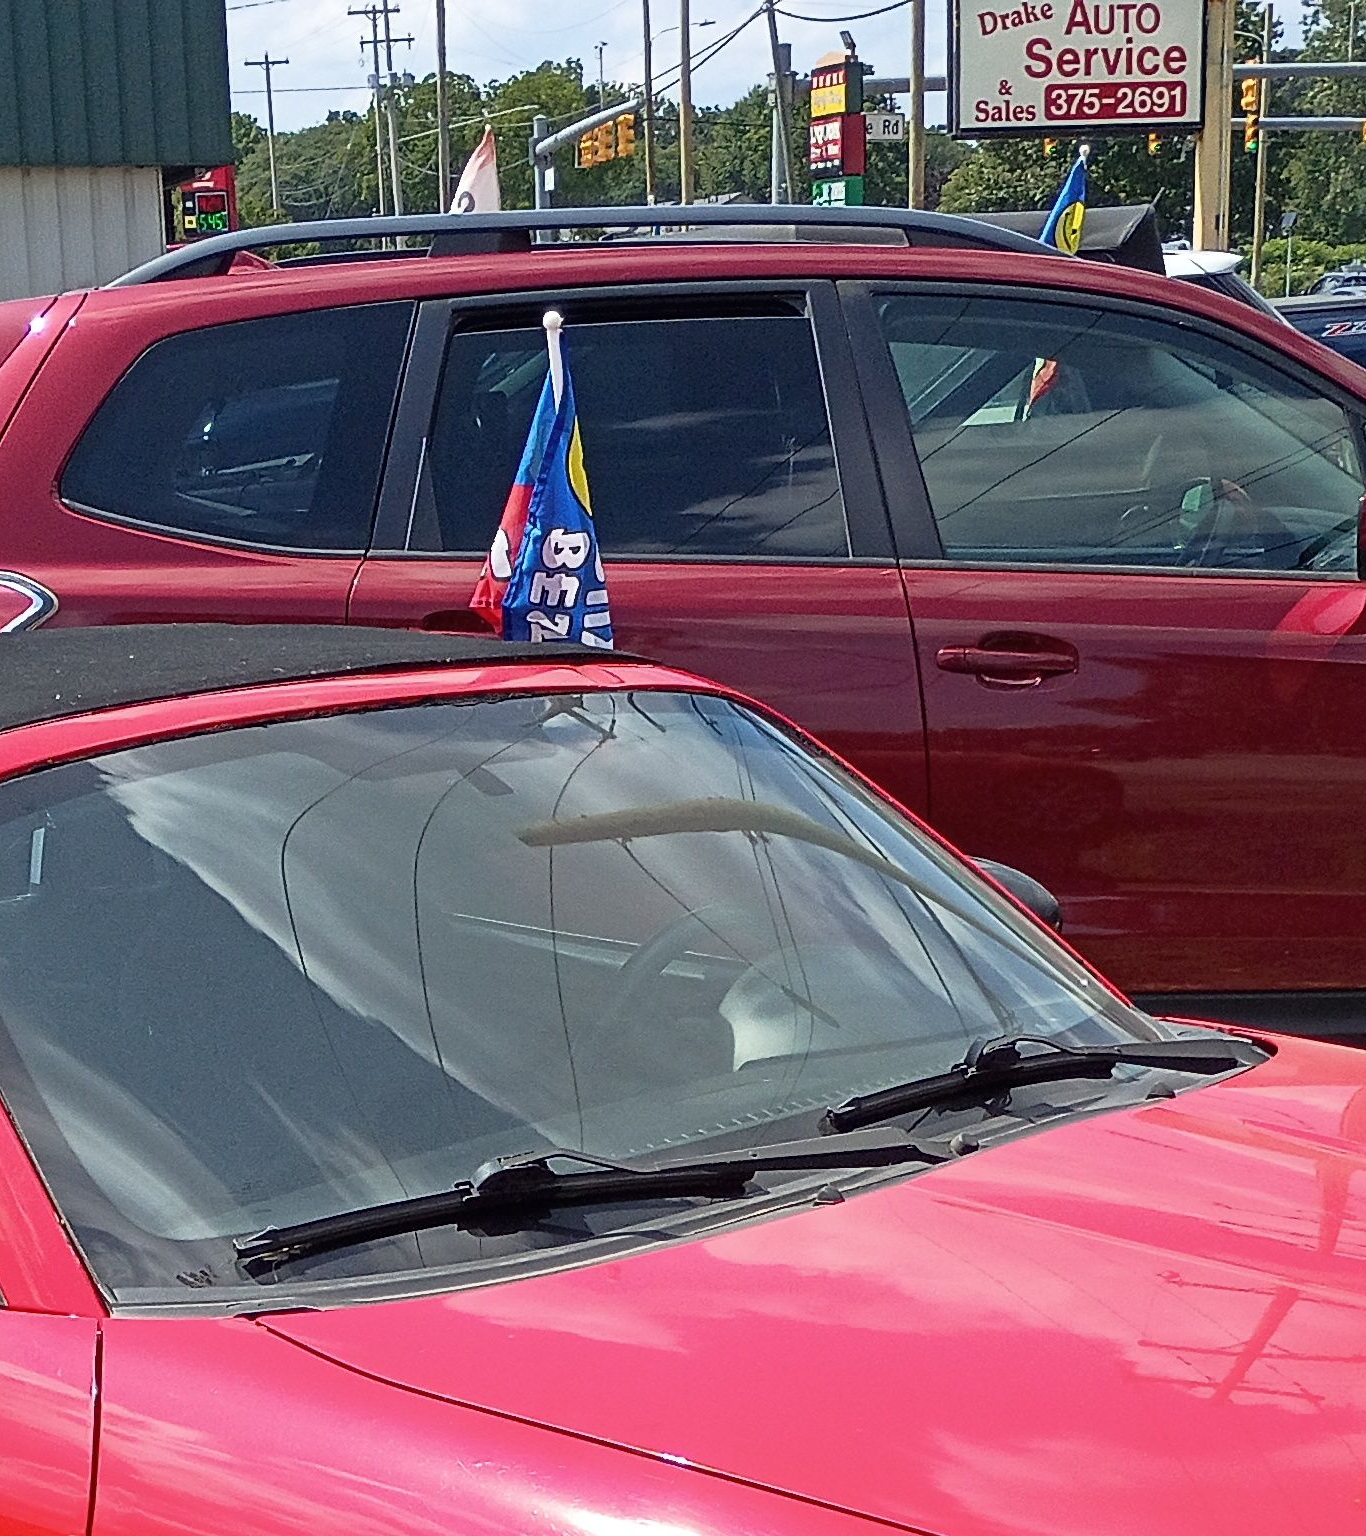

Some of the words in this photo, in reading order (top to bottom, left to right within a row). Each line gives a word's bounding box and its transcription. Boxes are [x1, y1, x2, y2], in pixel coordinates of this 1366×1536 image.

[977, 2, 1054, 36] Drake
[1064, 0, 1161, 35] AUTO
[1024, 37, 1187, 79] Service
[998, 80, 1013, 96] &
[1050, 88, 1182, 116] 375-2691
[975, 99, 1036, 123] Sales
[882, 119, 899, 136] Rd
